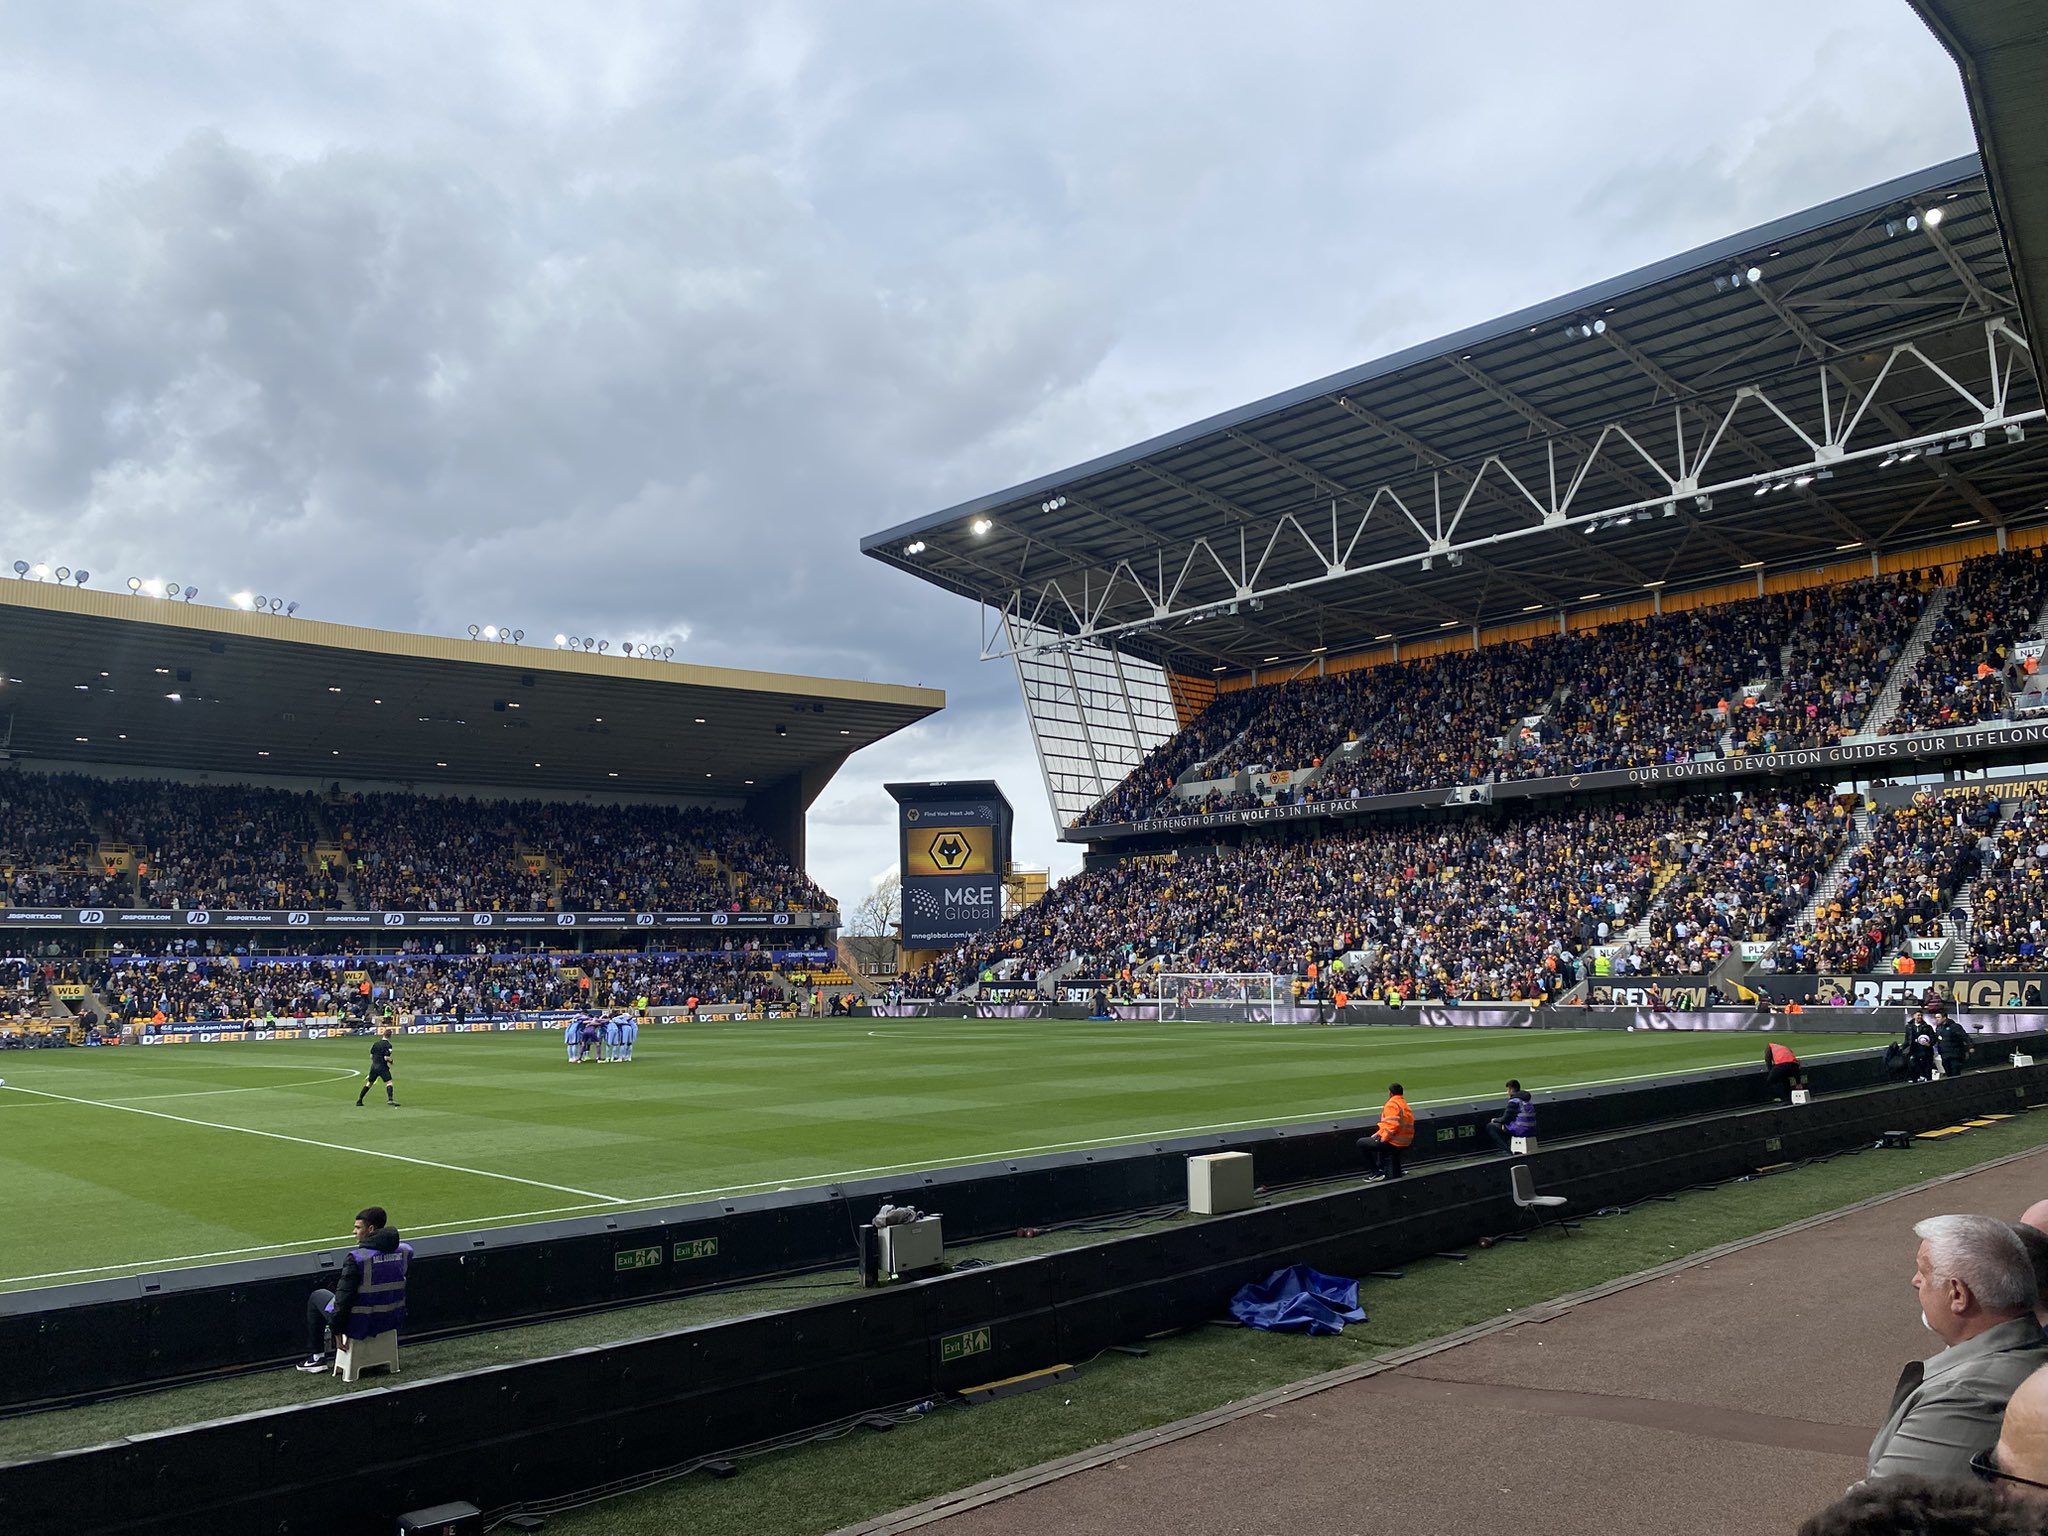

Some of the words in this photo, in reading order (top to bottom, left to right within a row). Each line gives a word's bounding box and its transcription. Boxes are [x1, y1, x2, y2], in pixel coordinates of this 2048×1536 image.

[1628, 768, 1660, 782] OUR
[1666, 761, 1726, 778] LOVING
[1733, 752, 1821, 772] DEVOTION
[1829, 742, 1898, 761] GUIDES
[1907, 737, 1945, 753] OUR
[1132, 820, 1149, 832] THE
[1152, 816, 1200, 830] STRENGTH
[1202, 815, 1215, 826] OF
[1218, 812, 1237, 824] THE
[1240, 809, 1271, 822] WOLF
[1274, 807, 1285, 818] IS
[1289, 805, 1301, 817] IN
[1306, 802, 1326, 815] THE
[1330, 800, 1358, 812] PACK
[944, 886, 994, 907] M&E
[6, 912, 63, 920] JDSPORTS.COM
[944, 905, 995, 920] Global
[1748, 945, 1766, 955] PL2
[1918, 941, 1941, 951] NL5
[58, 987, 80, 995] WL6
[676, 1248, 691, 1256] Exit
[617, 1256, 633, 1266] Exit
[944, 1342, 961, 1354] Exit
